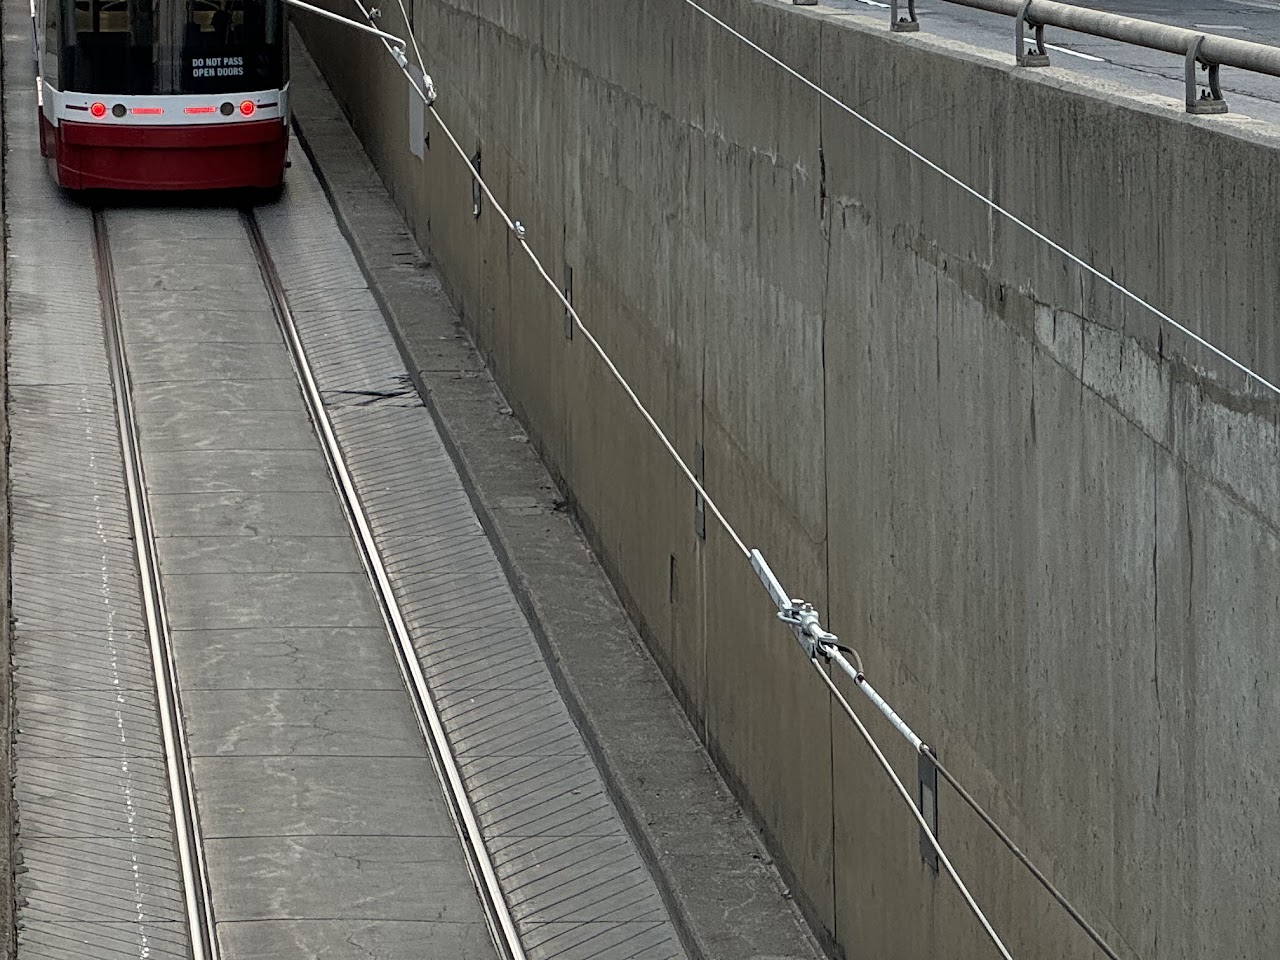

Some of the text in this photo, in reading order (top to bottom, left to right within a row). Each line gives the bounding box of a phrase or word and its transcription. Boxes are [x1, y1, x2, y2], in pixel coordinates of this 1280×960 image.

[192, 56, 243, 67] DO NOT PASS
[192, 66, 244, 77] OPEN DOORS
